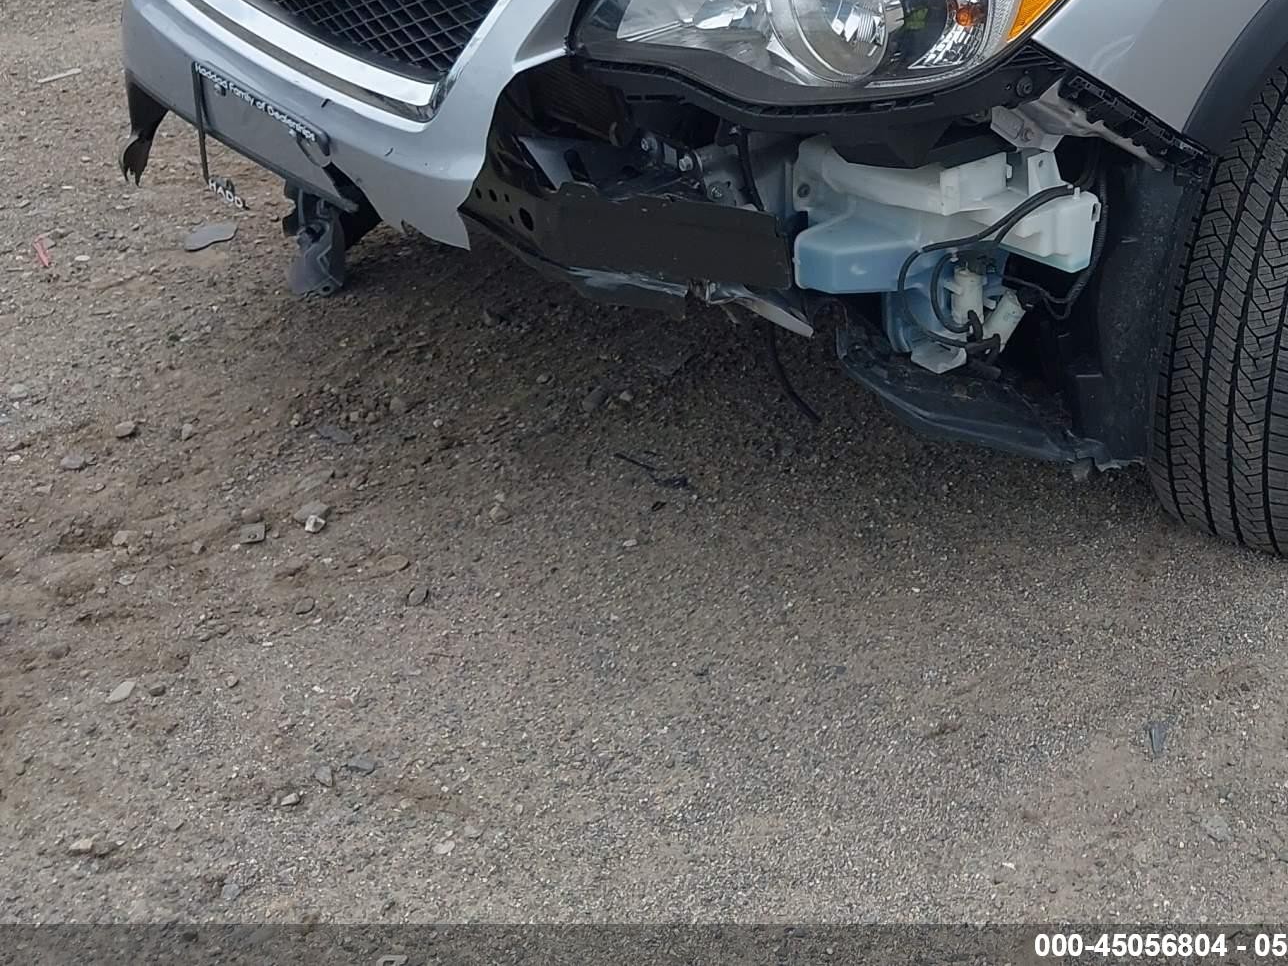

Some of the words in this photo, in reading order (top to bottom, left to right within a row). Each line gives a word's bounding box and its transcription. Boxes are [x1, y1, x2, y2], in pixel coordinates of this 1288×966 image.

[194, 62, 228, 90] Haddad
[228, 81, 255, 107] Family
[256, 100, 267, 112] of
